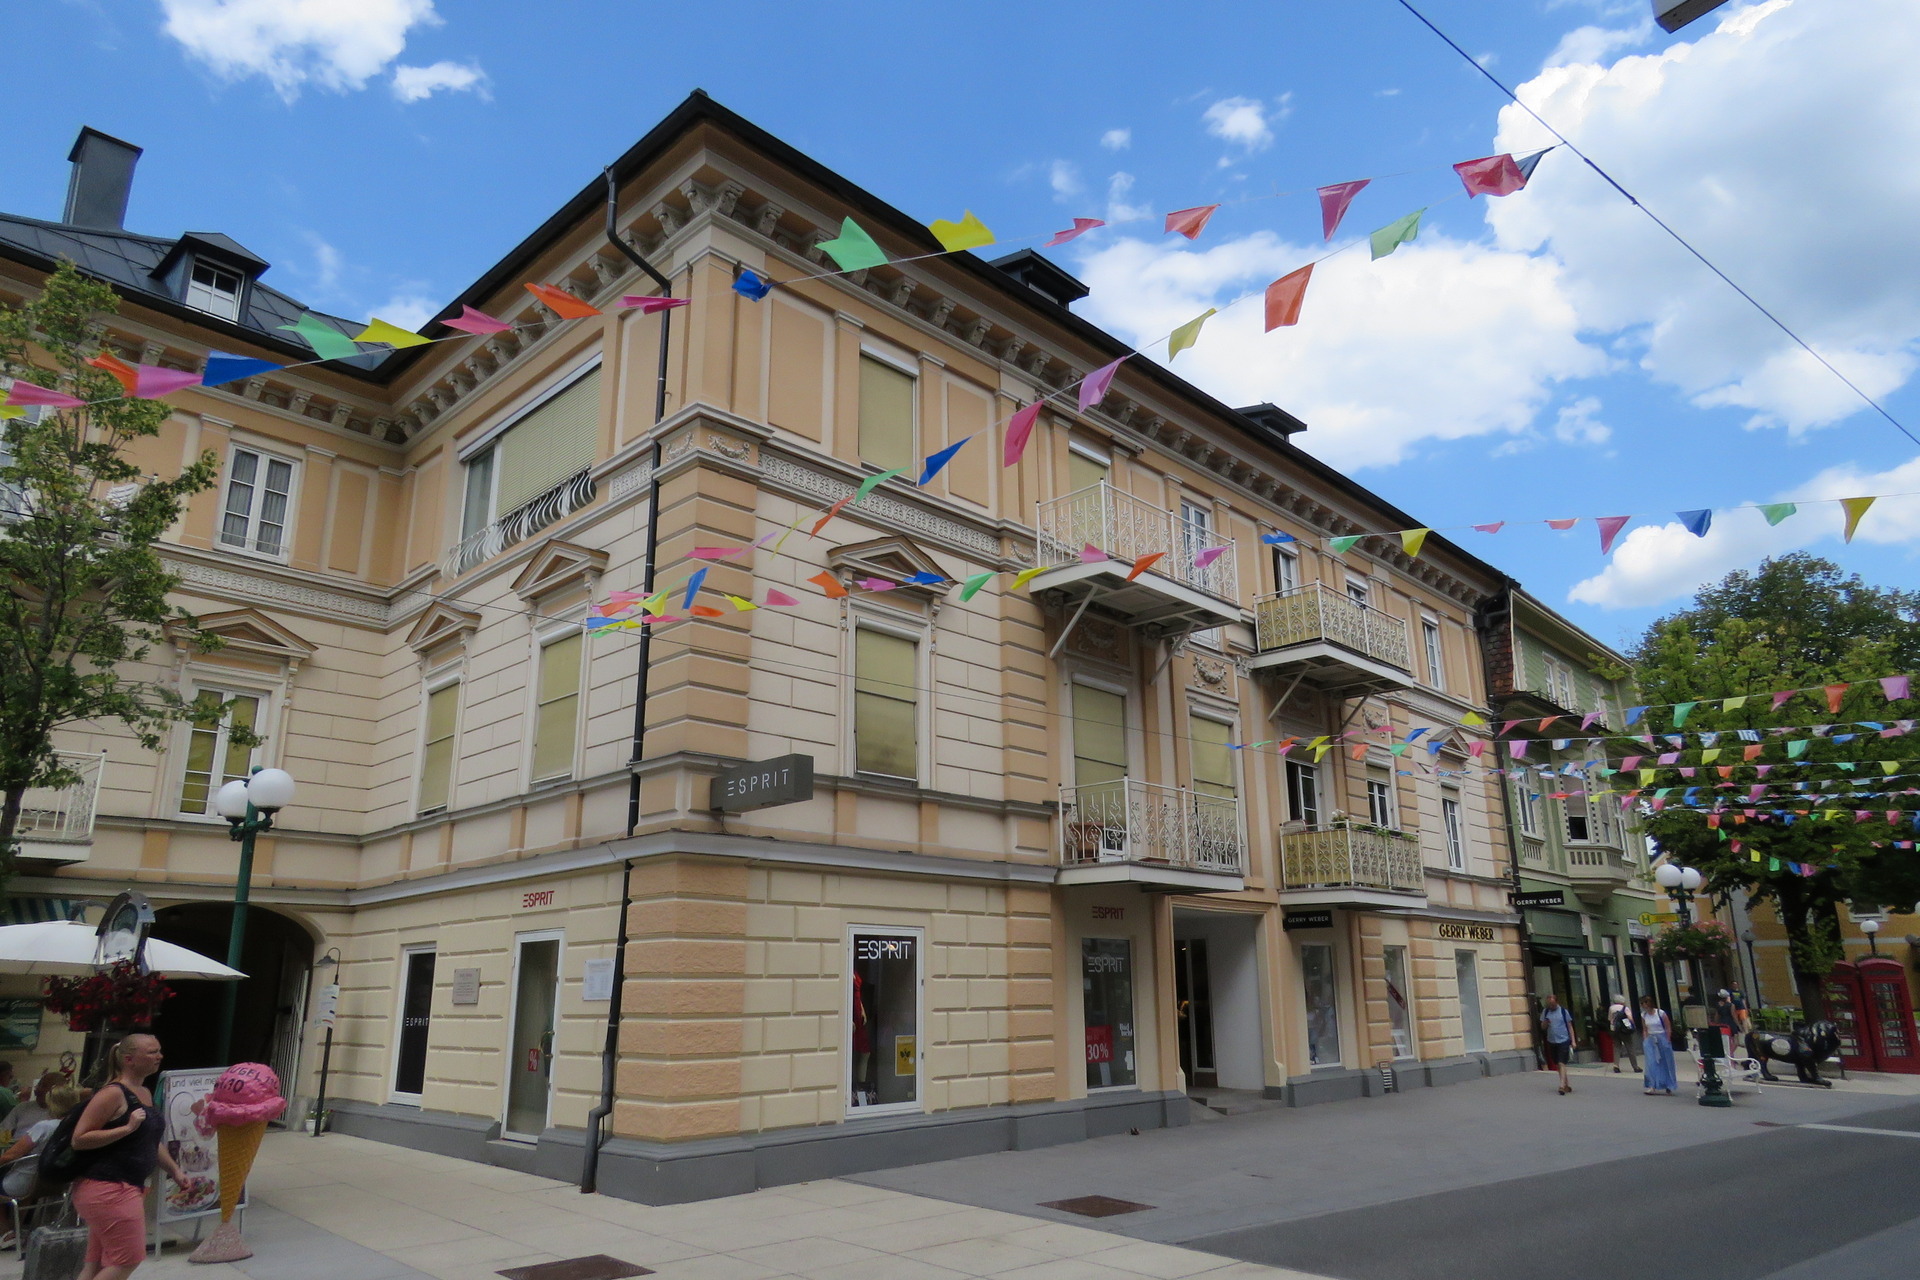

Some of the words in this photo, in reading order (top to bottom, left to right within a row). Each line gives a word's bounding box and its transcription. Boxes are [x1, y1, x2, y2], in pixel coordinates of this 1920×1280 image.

[727, 768, 789, 797] ESPRIT
[523, 890, 555, 908] ESPRIT
[1092, 906, 1124, 920] ESPRIT
[1439, 923, 1465, 939] GERRY
[1467, 926, 1494, 941] WEBER
[858, 940, 912, 960] ESPRIT
[1088, 956, 1124, 973] ESPRIT
[406, 1017, 429, 1026] ESPRIT
